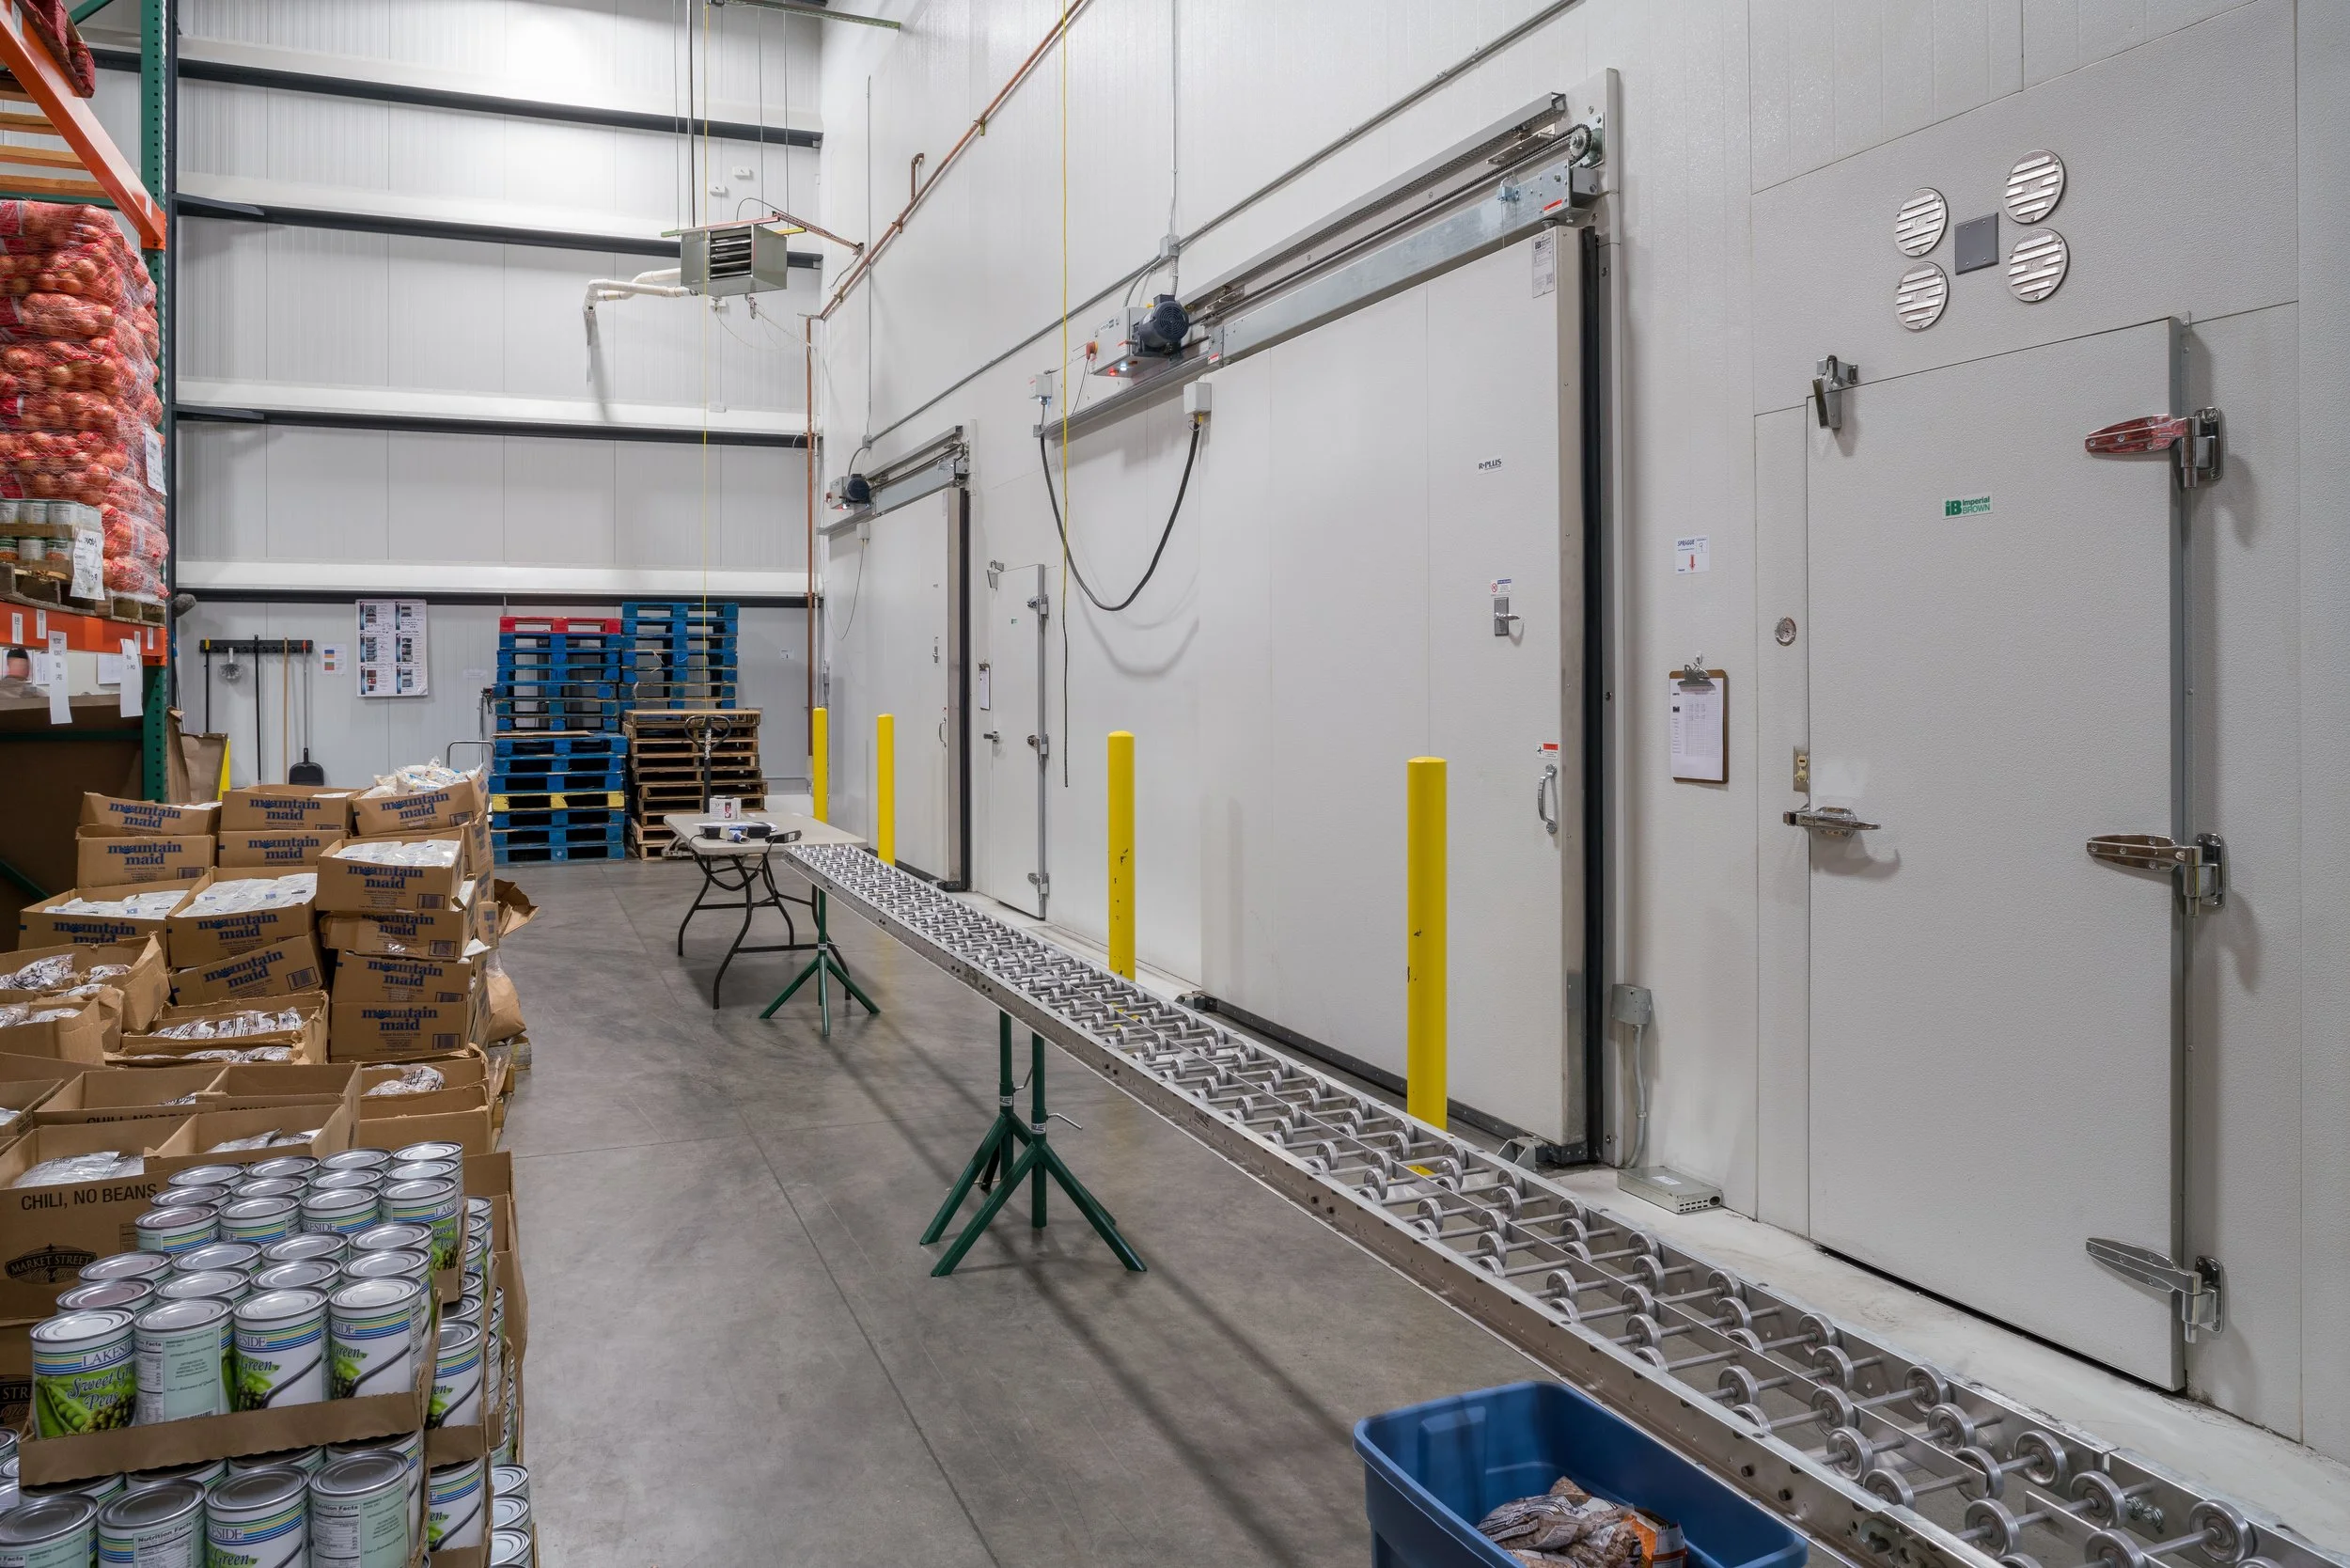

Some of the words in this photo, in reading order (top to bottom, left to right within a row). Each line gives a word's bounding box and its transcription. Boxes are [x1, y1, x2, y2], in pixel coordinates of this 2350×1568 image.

[1963, 504, 1990, 514] BROWN
[249, 799, 321, 810] mountain
[381, 792, 449, 811] mountain
[108, 801, 180, 819] mountain
[266, 809, 305, 821] maid
[399, 805, 436, 820] maid
[123, 815, 164, 828] maid
[107, 841, 182, 855] mountain
[248, 836, 320, 849] mountain
[125, 854, 164, 865] maid
[264, 848, 304, 859] maid
[347, 865, 425, 878] mountain
[365, 877, 406, 889] maid
[196, 912, 278, 930] mountain
[53, 921, 135, 935] mountain
[218, 925, 261, 940] maid
[380, 924, 417, 936] maid
[203, 950, 284, 982] mountain
[367, 961, 444, 977] mountain
[227, 965, 271, 987] maid
[384, 974, 425, 987] maid
[361, 1006, 438, 1019] mountain
[380, 1019, 420, 1031] maid
[21, 1192, 68, 1211] CHILI,
[74, 1188, 98, 1205] NO
[102, 1184, 158, 1203] BEANS
[11, 1256, 53, 1274] MARKET
[54, 1255, 90, 1265] STREET
[68, 1372, 115, 1399] Sweet
[84, 1391, 118, 1410] Peas
[138, 1530, 173, 1543] Nutrition
